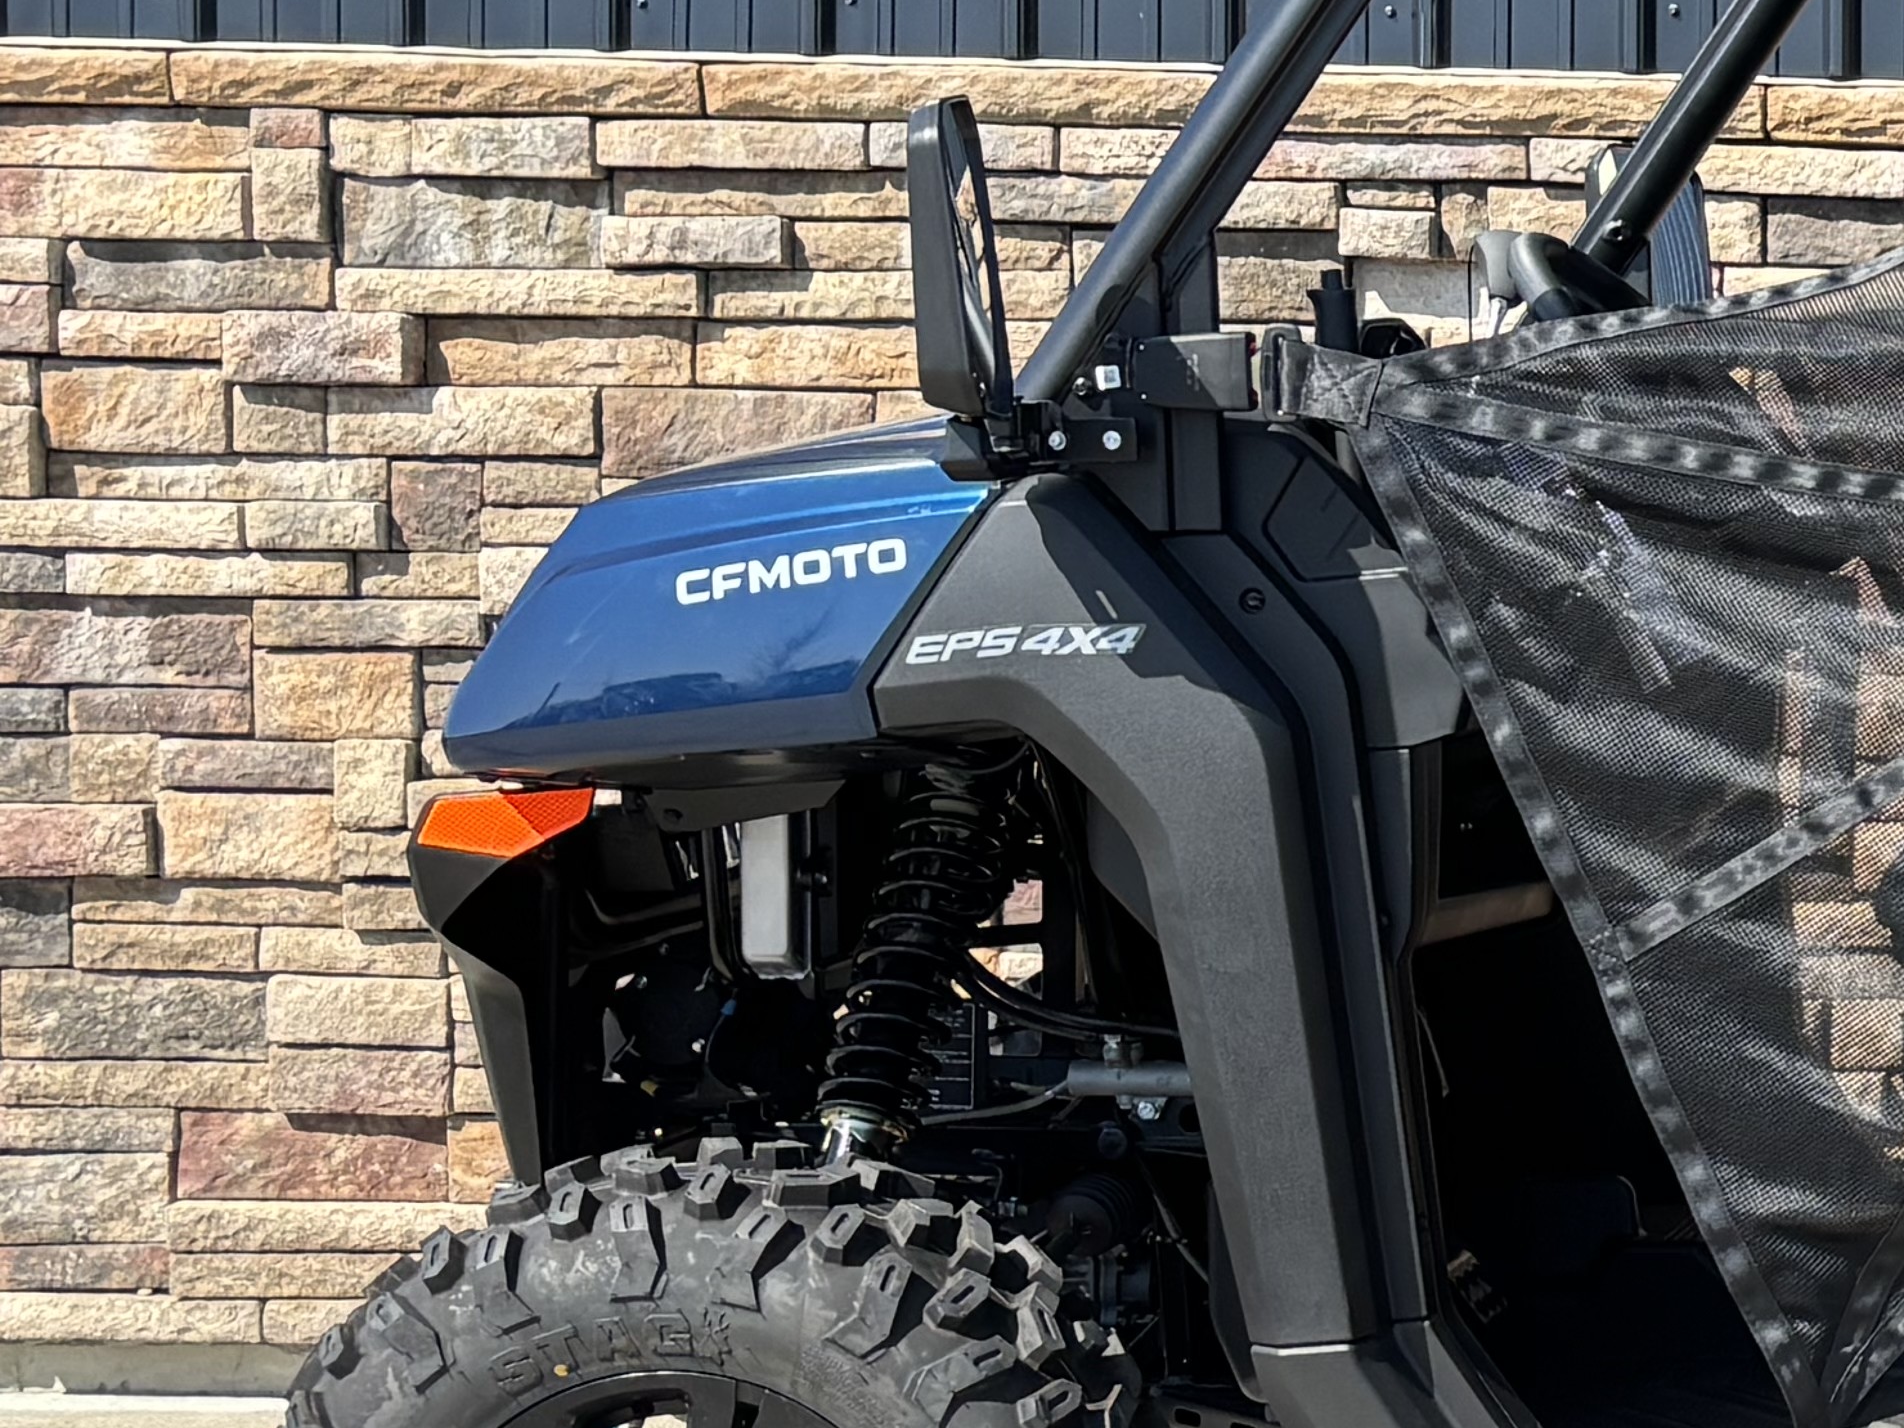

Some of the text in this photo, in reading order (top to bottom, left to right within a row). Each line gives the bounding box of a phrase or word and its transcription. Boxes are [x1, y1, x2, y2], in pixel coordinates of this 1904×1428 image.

[675, 537, 908, 606] CFMOTO
[905, 626, 1140, 665] EPS 4X4
[488, 1309, 694, 1398] STAG
